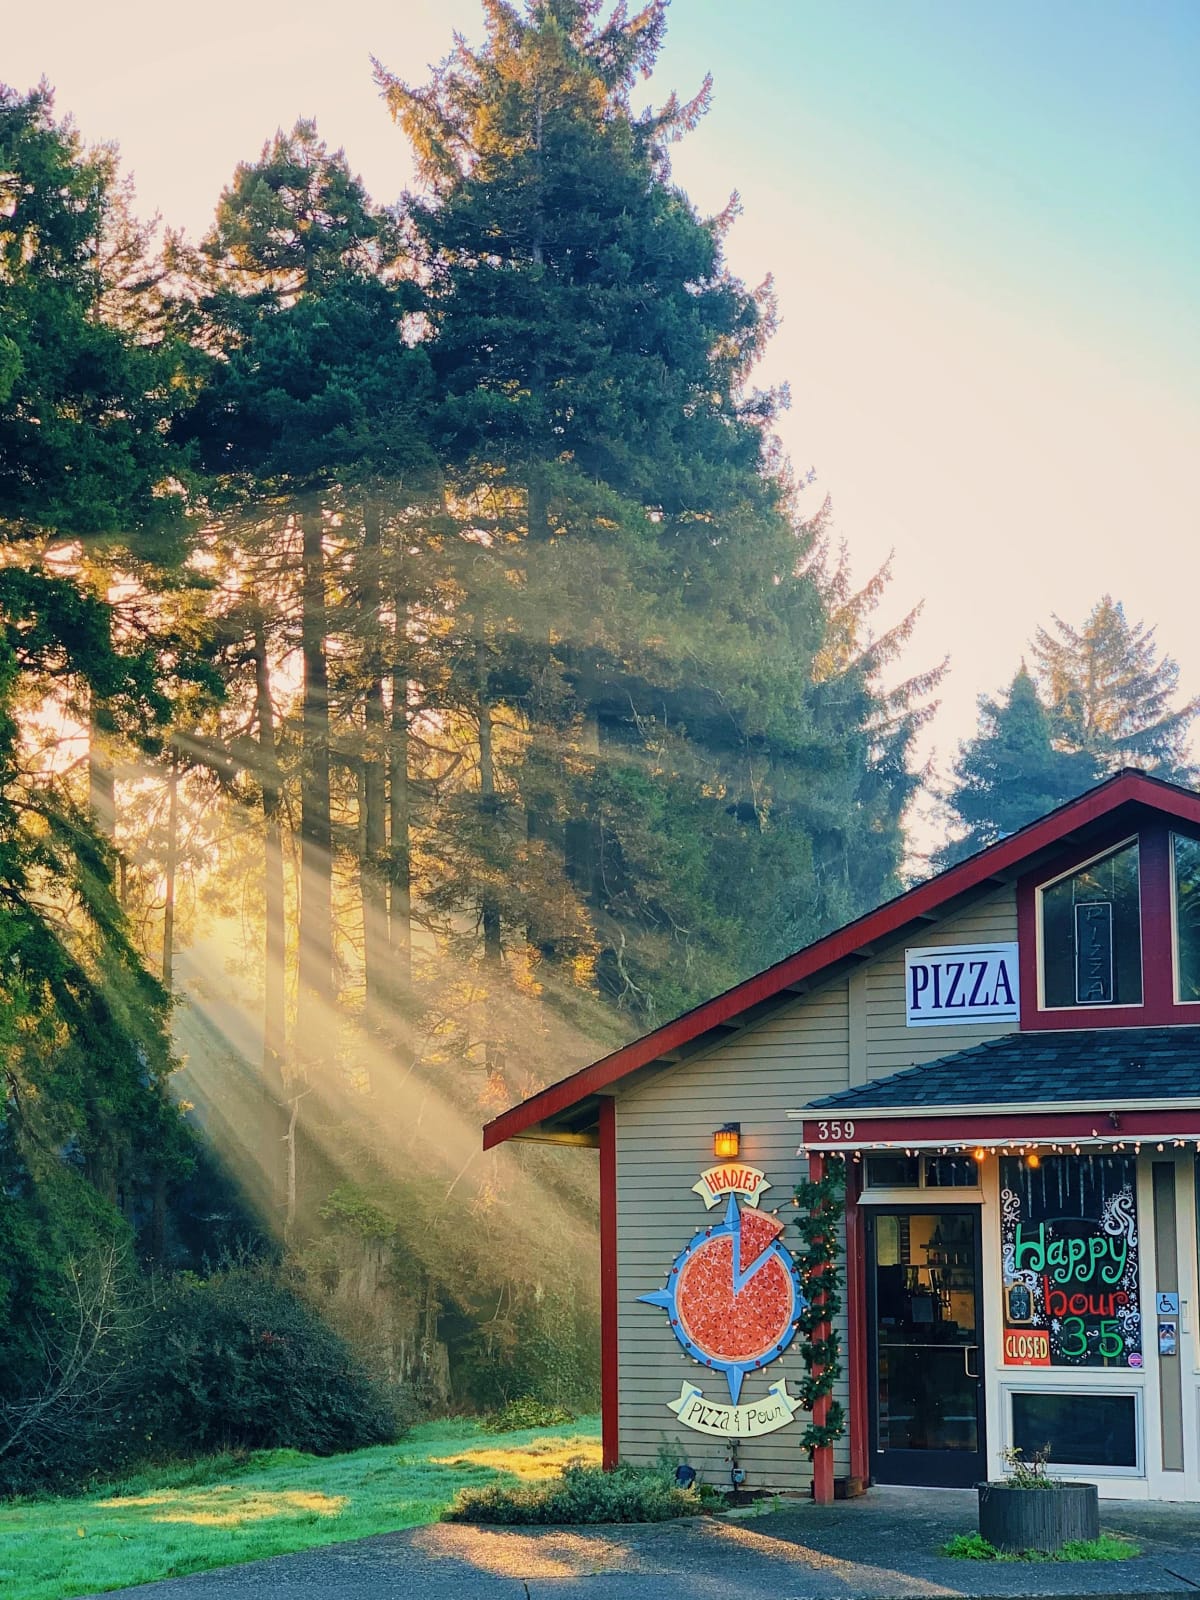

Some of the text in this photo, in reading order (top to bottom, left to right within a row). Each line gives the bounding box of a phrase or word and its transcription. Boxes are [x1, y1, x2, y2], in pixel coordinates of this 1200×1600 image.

[1086, 906, 1105, 999] PIZZA
[910, 959, 1016, 1010] PIZZA
[818, 1121, 855, 1140] 359
[704, 1168, 761, 1194] HEADIES
[1015, 1222, 1127, 1284] Happy
[1043, 1274, 1129, 1316] hour
[1005, 1335, 1048, 1359] CLOSED
[733, 1410, 741, 1432] &
[746, 1405, 786, 1431] Pour
